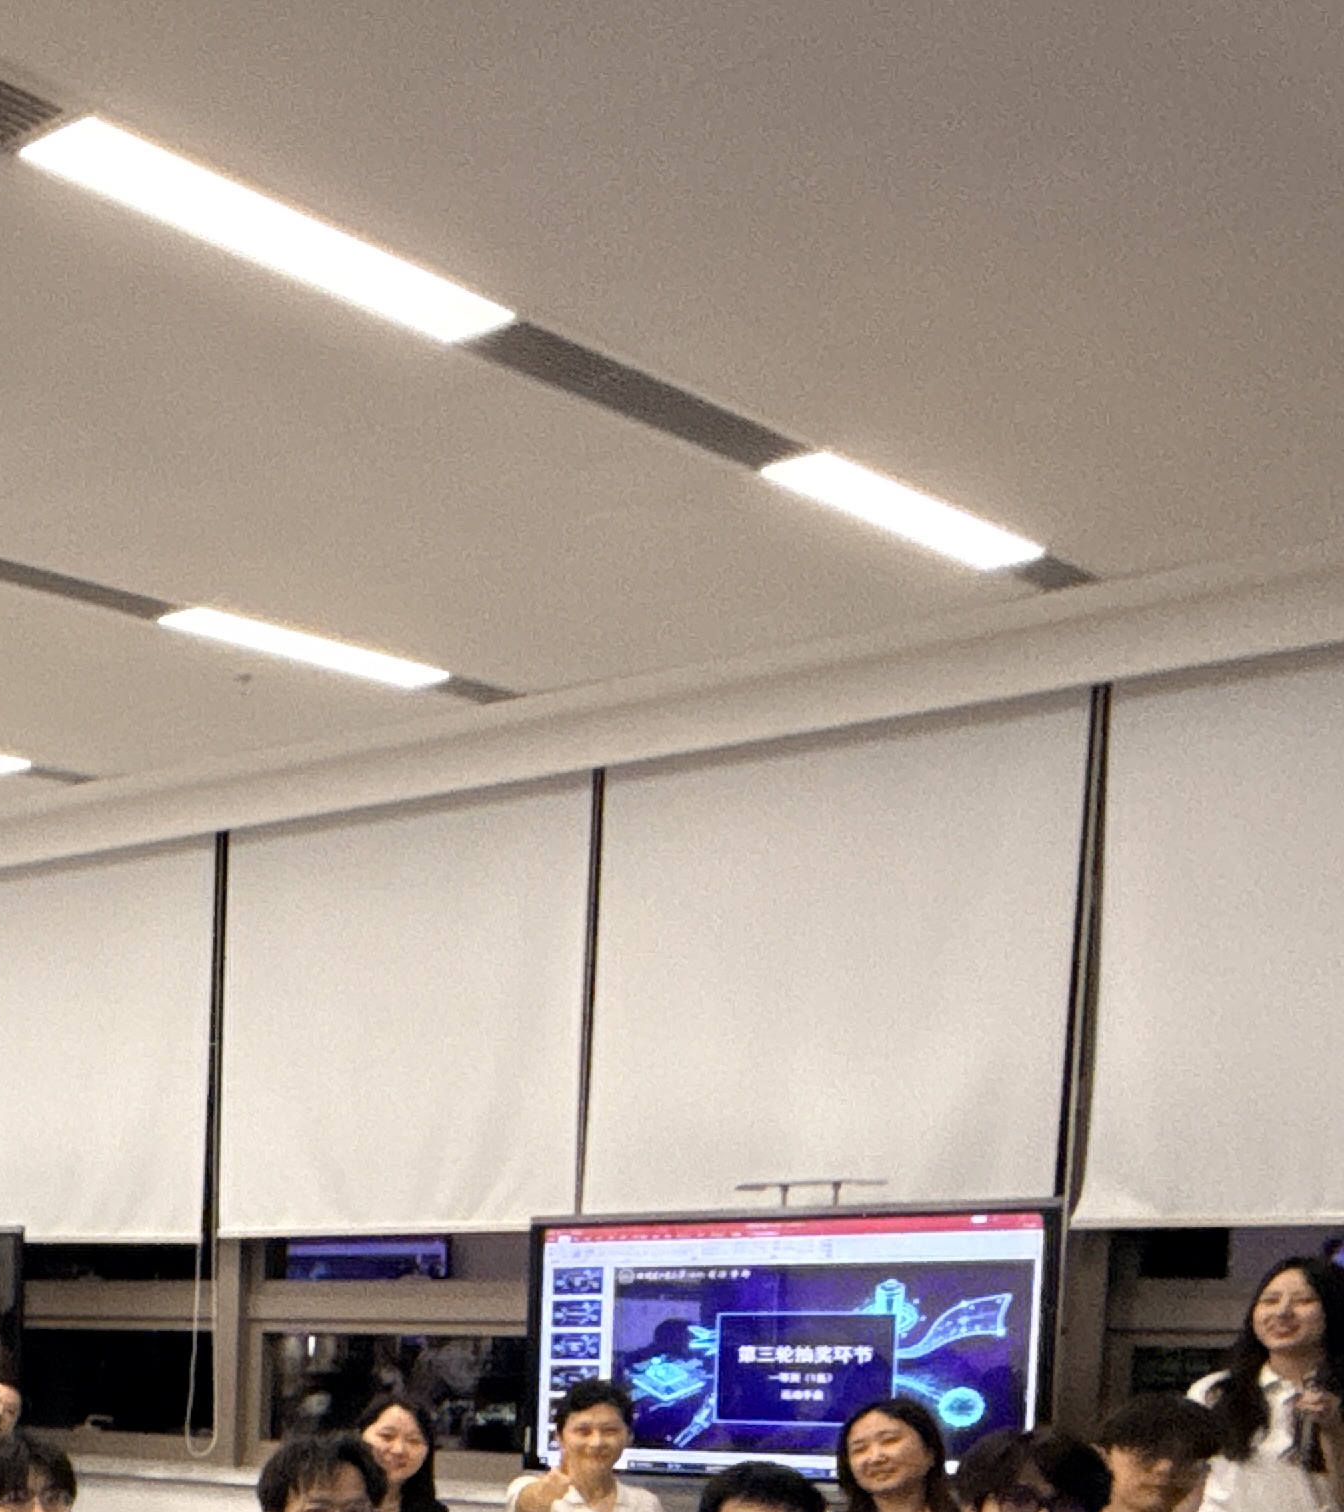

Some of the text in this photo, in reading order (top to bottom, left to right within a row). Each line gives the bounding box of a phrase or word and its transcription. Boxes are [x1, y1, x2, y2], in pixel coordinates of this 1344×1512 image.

[737, 1344, 874, 1366] 第三轮抽奖环节
